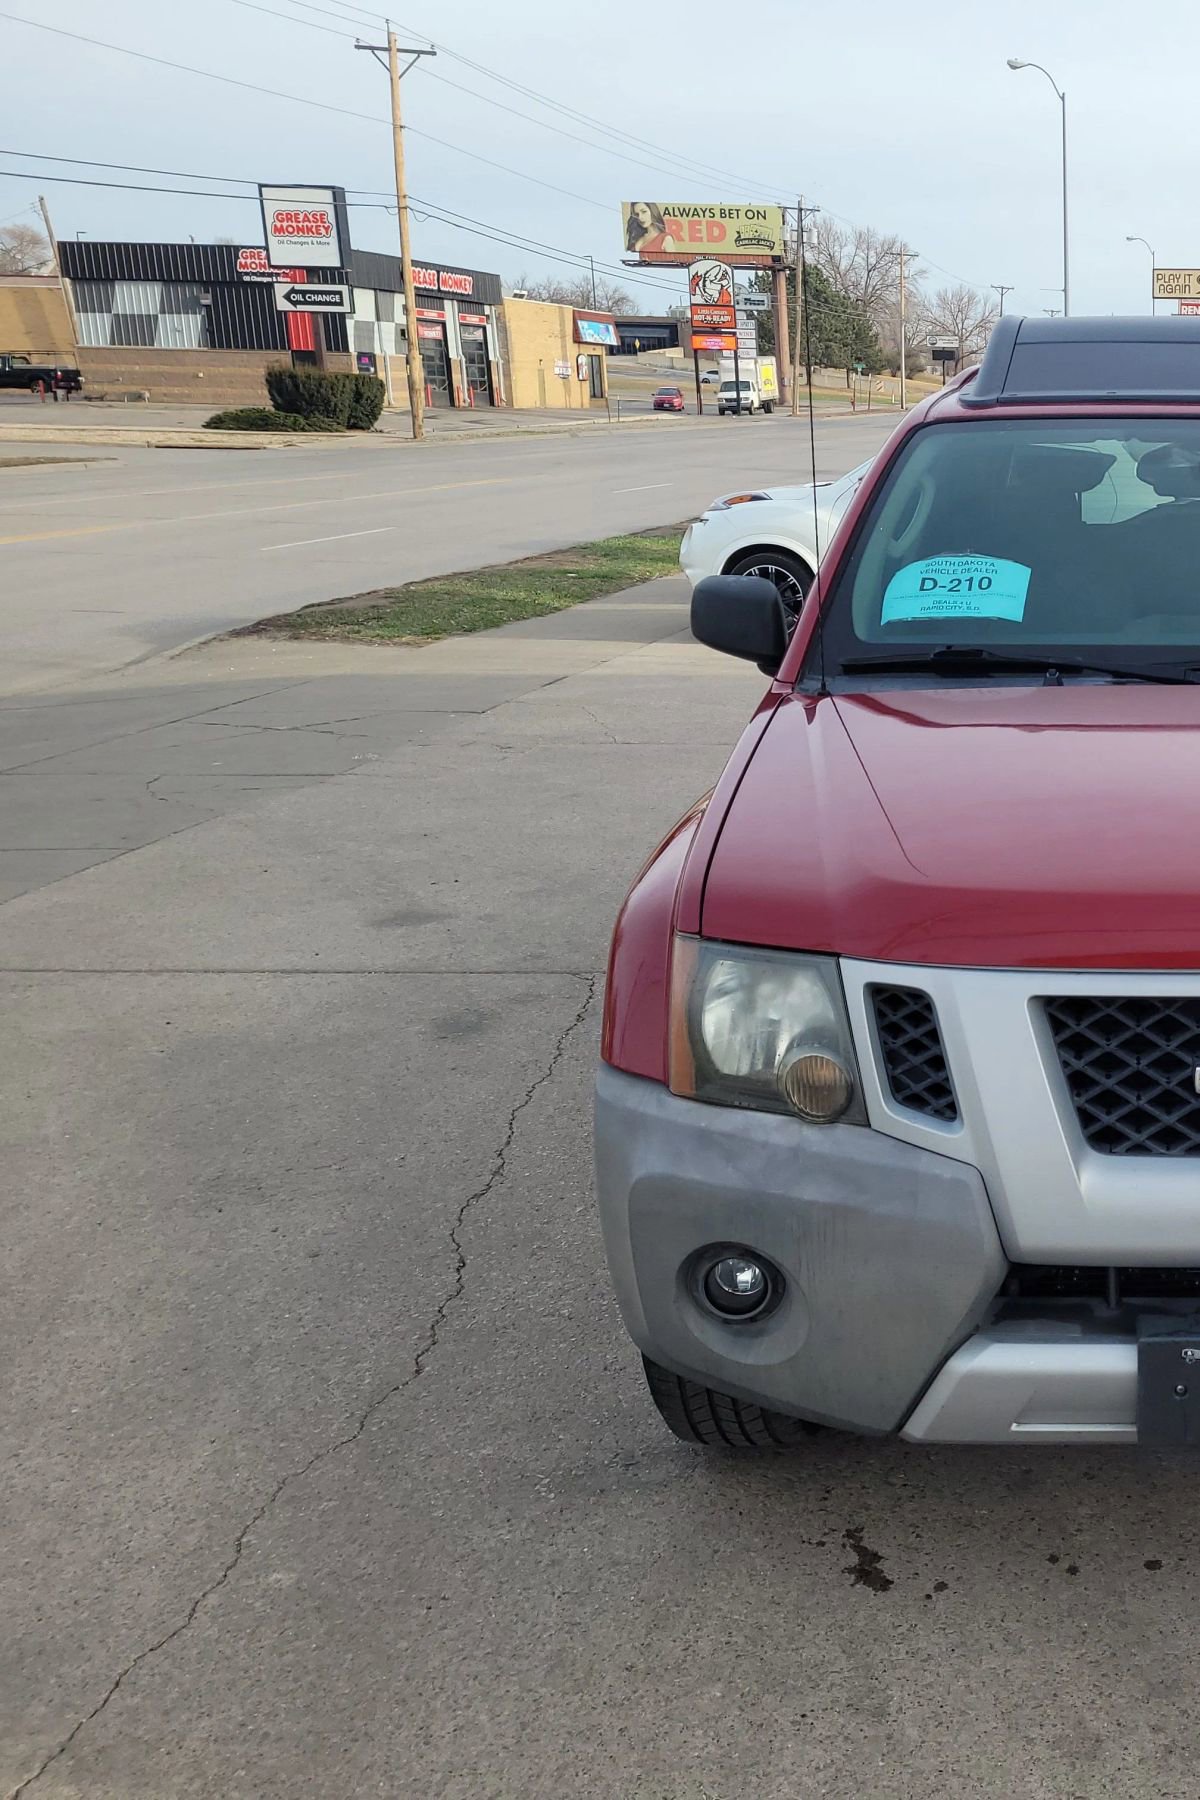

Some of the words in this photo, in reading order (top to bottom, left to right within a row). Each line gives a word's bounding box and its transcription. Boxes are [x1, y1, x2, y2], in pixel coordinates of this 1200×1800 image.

[274, 211, 328, 224] GREASE
[663, 207, 715, 219] ALWAYS
[720, 208, 741, 219] BET
[745, 209, 767, 220] ON
[272, 223, 332, 236] MONKEY
[664, 219, 727, 243] RED
[411, 268, 438, 290] REASE
[440, 271, 474, 295] MONKEY
[1156, 274, 1181, 283] PLAY
[1183, 274, 1192, 283] IT
[1158, 284, 1191, 294] AGAIN
[290, 293, 304, 301] OIL
[305, 294, 341, 302] CHANGE
[919, 576, 993, 593] D-210
